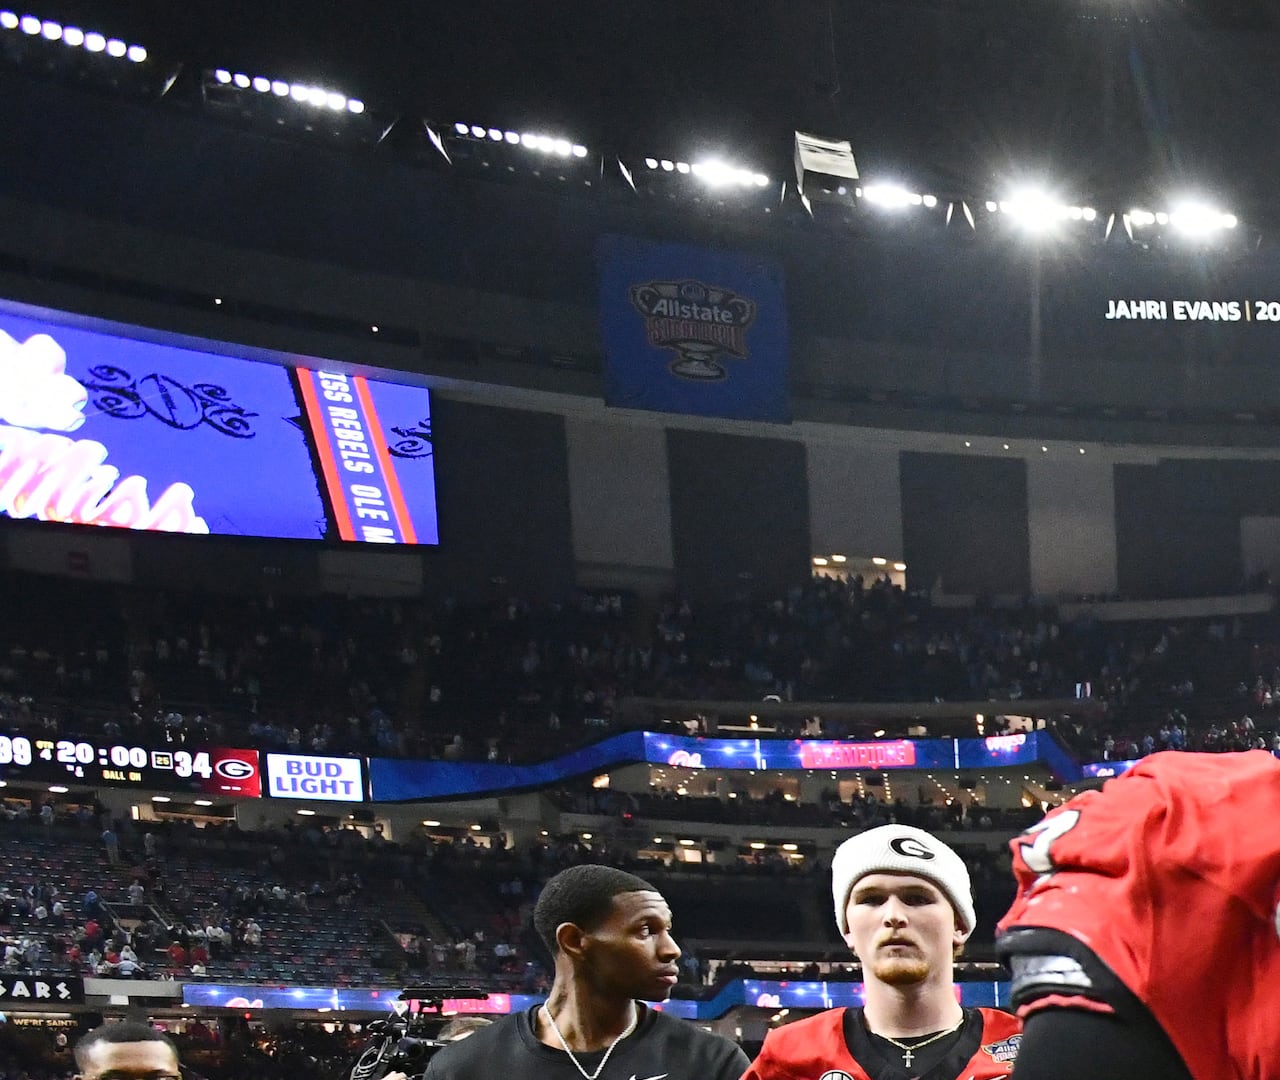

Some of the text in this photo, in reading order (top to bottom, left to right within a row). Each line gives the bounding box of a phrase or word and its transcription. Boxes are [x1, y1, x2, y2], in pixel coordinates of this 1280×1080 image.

[652, 298, 733, 324] Allstate
[1104, 300, 1168, 320] JAHRI
[1173, 301, 1242, 322] EVANS
[327, 404, 374, 475] REBELS
[351, 484, 389, 523] OLE
[56, 740, 148, 768] 20:00
[174, 750, 213, 779] 34
[103, 769, 127, 781] BALL
[286, 760, 343, 778] BUD
[276, 776, 355, 796] LIGHT
